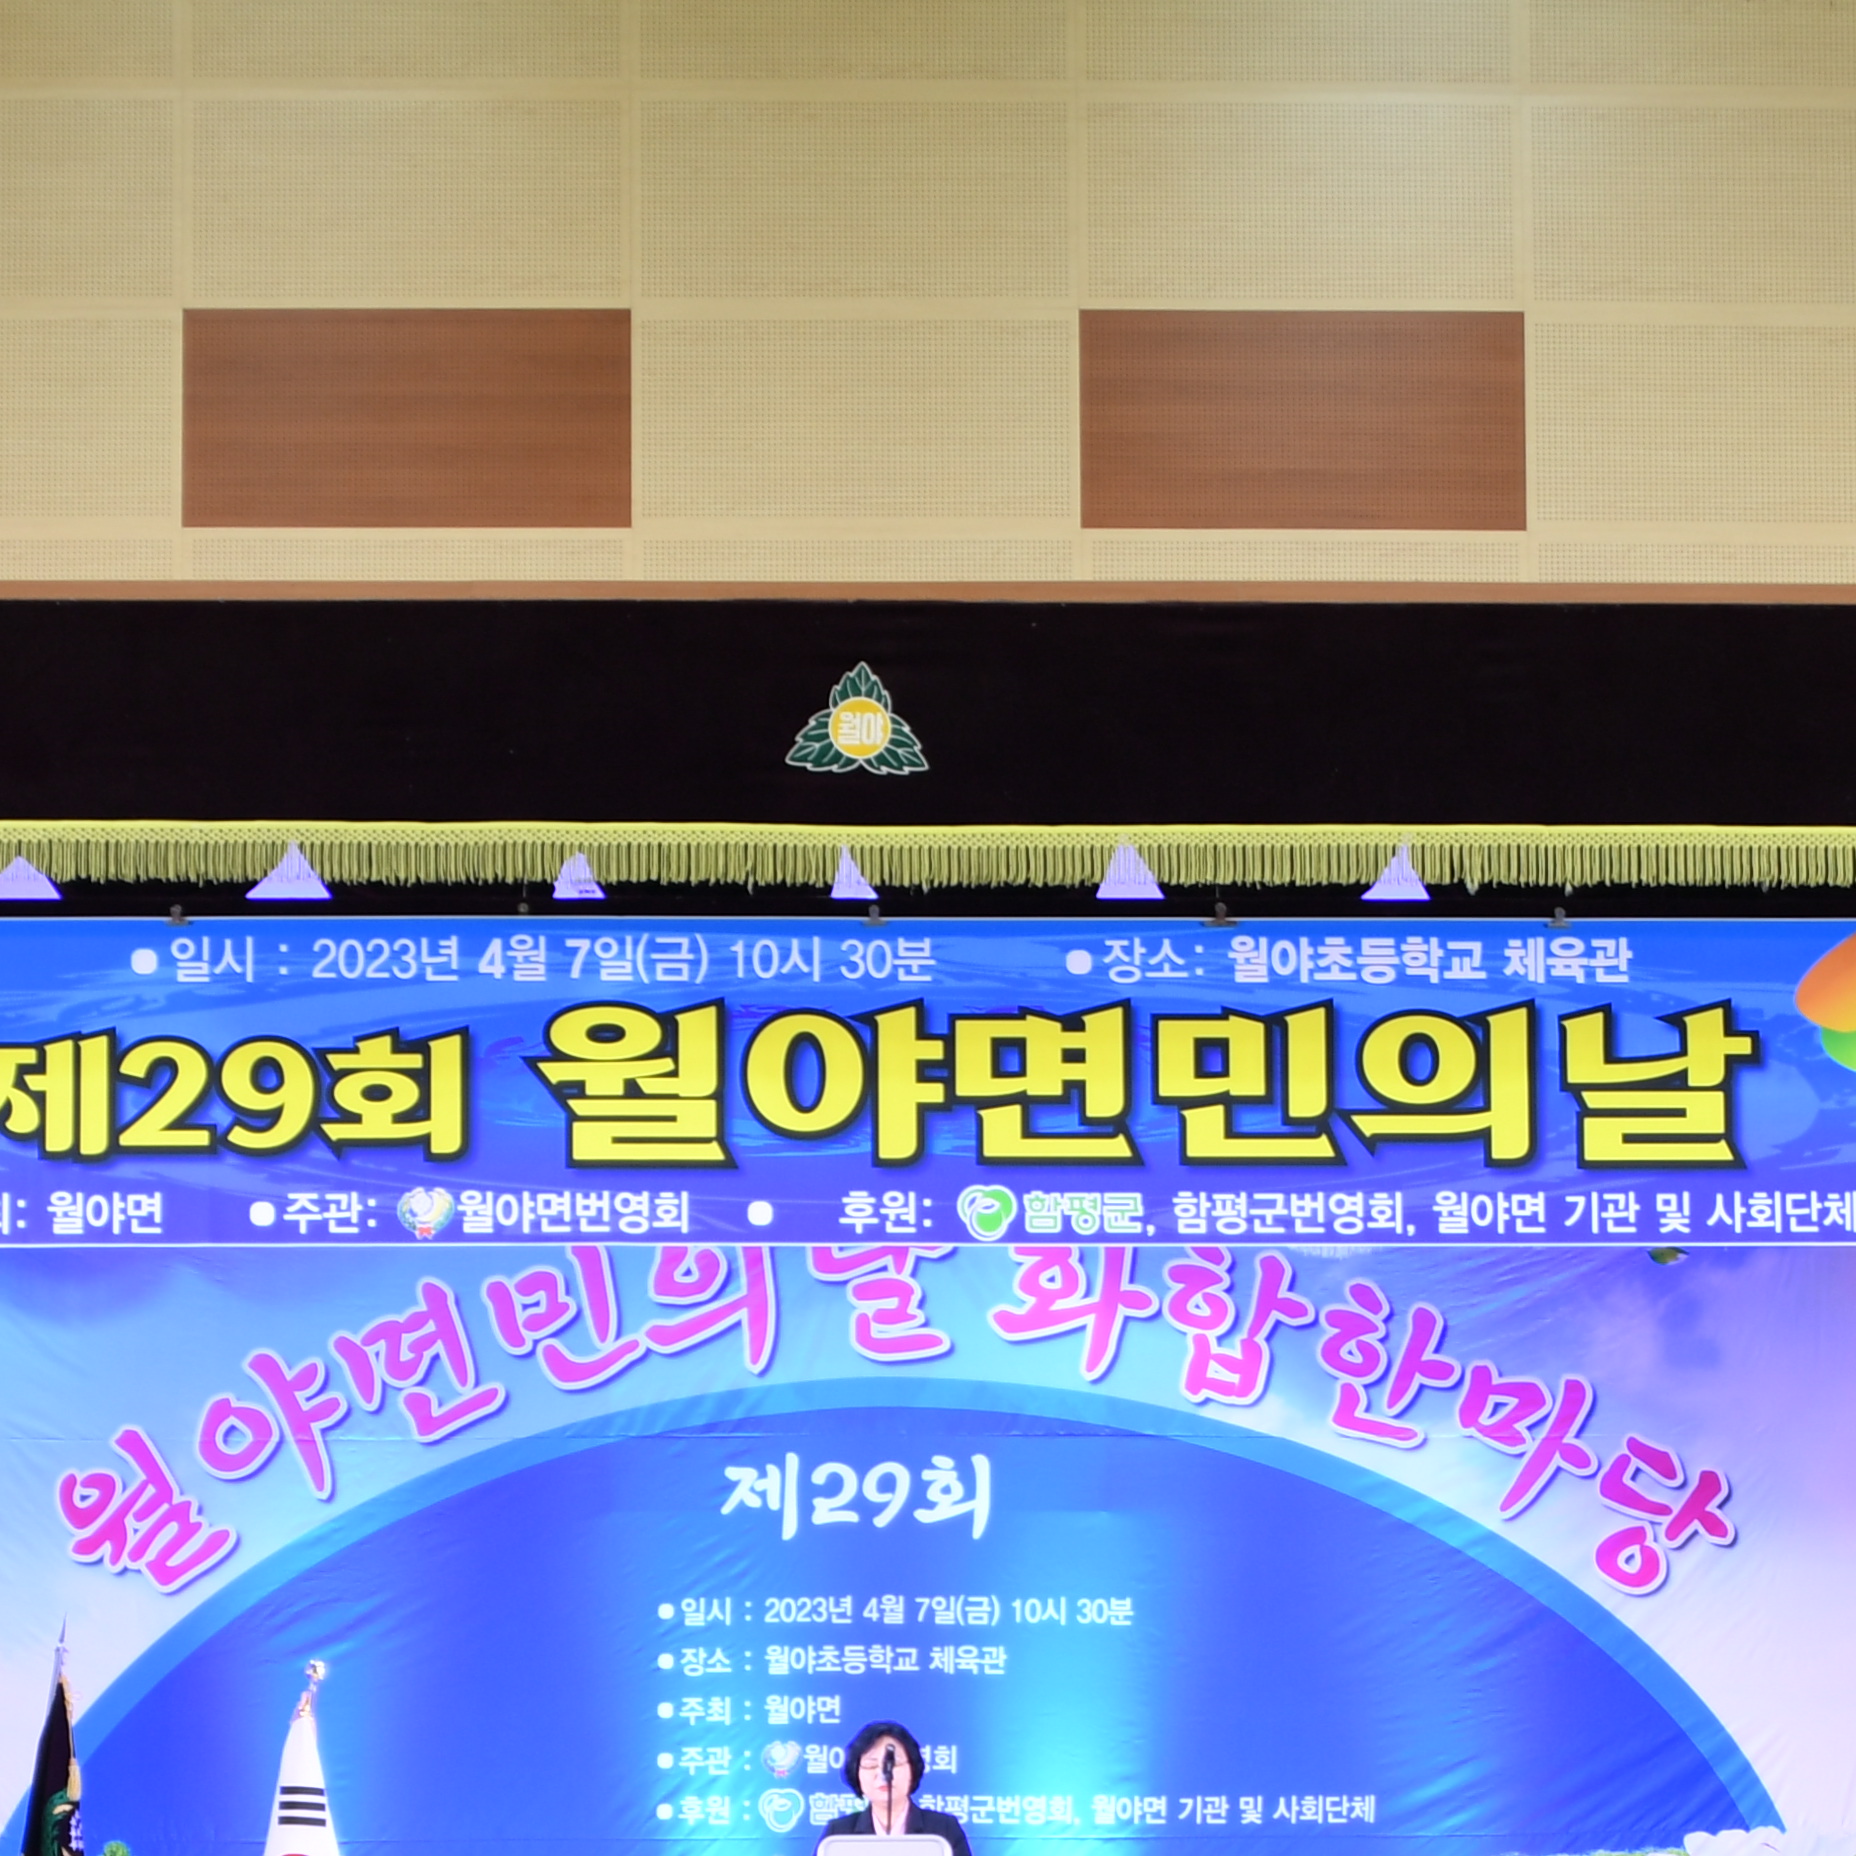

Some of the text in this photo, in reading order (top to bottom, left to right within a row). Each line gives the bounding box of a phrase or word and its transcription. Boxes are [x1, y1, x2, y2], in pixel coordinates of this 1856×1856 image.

[838, 711, 884, 746] 월야
[169, 935, 256, 982] 일시
[310, 937, 460, 982] 2023년
[478, 935, 549, 982] 4월
[565, 935, 710, 984] 7일(금)
[731, 936, 823, 983] 10시
[841, 937, 937, 984] 30분
[1102, 936, 1633, 985] 장소: 월야초등학교 체육관
[536, 997, 1756, 1171] 월야면민의날
[47, 1190, 164, 1235] 월야면
[282, 1190, 689, 1235] 주관: 월야면번영회
[838, 1190, 934, 1236] 후원:
[1171, 1190, 1416, 1237] 함평군번영회,
[1432, 1190, 1548, 1234] 월야면
[1564, 1190, 1641, 1235] 기관
[1656, 1190, 1693, 1235] 및
[720, 1451, 992, 1541] 제29회
[680, 1597, 733, 1626] 일시
[763, 1595, 853, 1624] 2023년
[862, 1595, 905, 1625] 4월
[915, 1594, 1000, 1627] 7일(금)
[1010, 1596, 1067, 1626] 10시
[1076, 1596, 1135, 1626] 30분
[679, 1646, 733, 1676] 장소
[763, 1645, 920, 1675] 월야초등학교
[929, 1645, 1008, 1676] 체육관
[679, 1695, 732, 1726] 주최
[763, 1694, 842, 1725] 월야면
[678, 1745, 731, 1776] 주관
[678, 1794, 731, 1825] 후원
[1090, 1795, 1168, 1825] 월야면
[1178, 1795, 1229, 1825] 기관
[1240, 1795, 1264, 1825] 및
[1272, 1795, 1376, 1825] 사회단체
